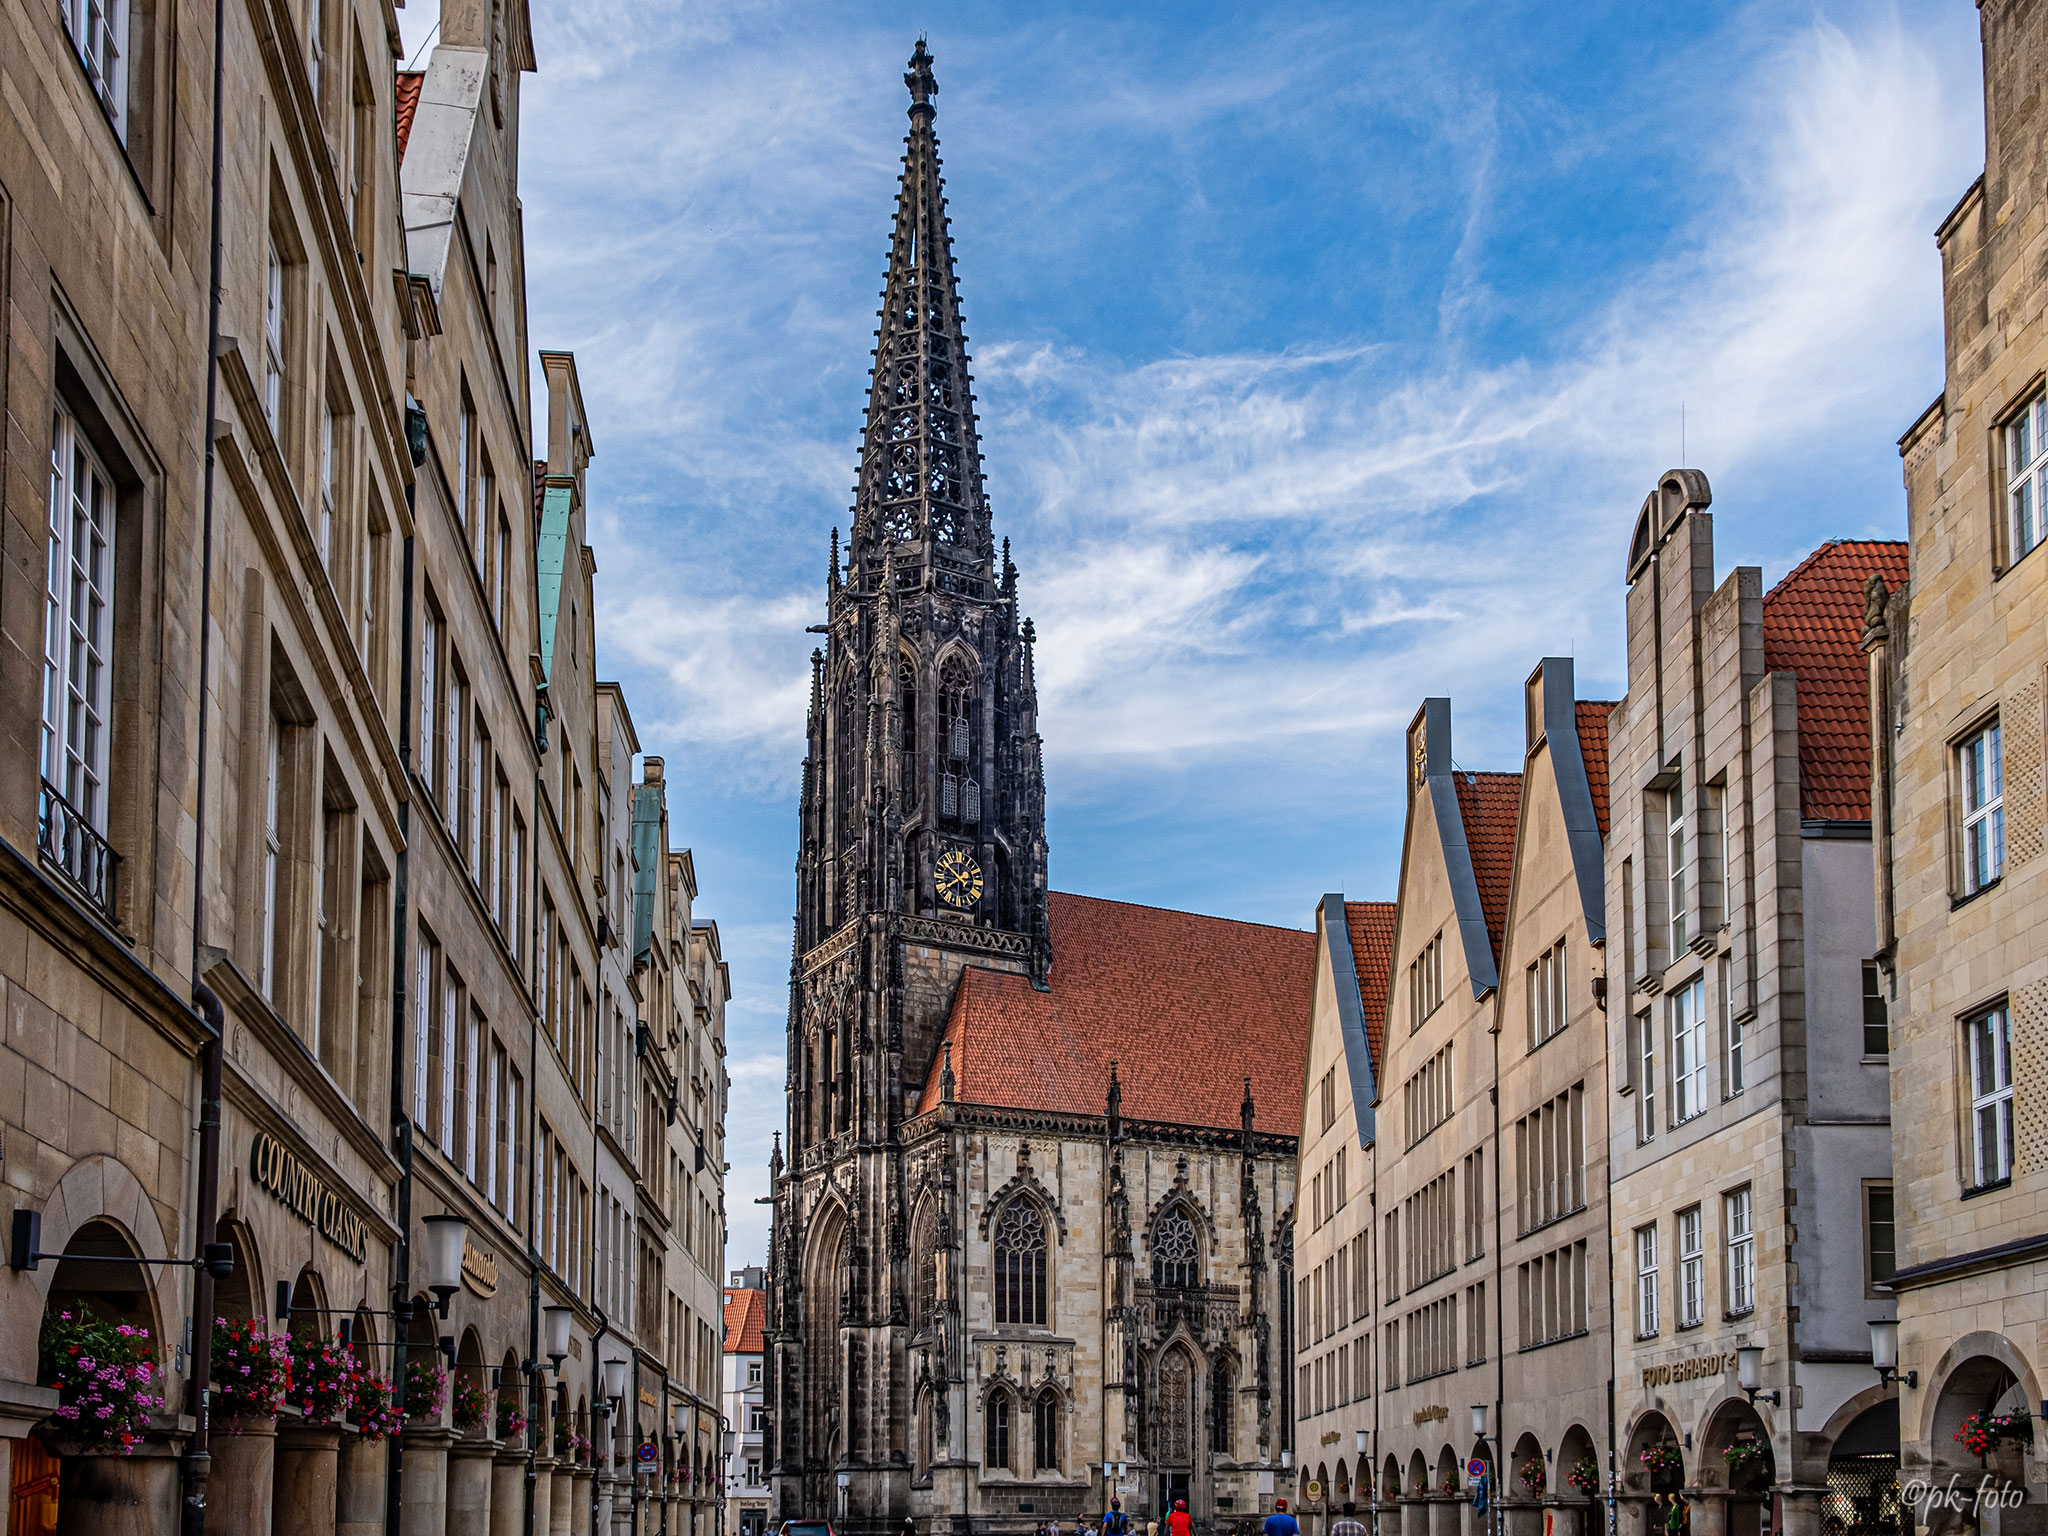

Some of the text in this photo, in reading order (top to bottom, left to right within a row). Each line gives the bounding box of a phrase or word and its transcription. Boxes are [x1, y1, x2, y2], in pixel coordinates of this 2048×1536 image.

[255, 1131, 370, 1263] COUNTRY CLASSICS
[1642, 1352, 1727, 1389] FOTO ERHARDT
